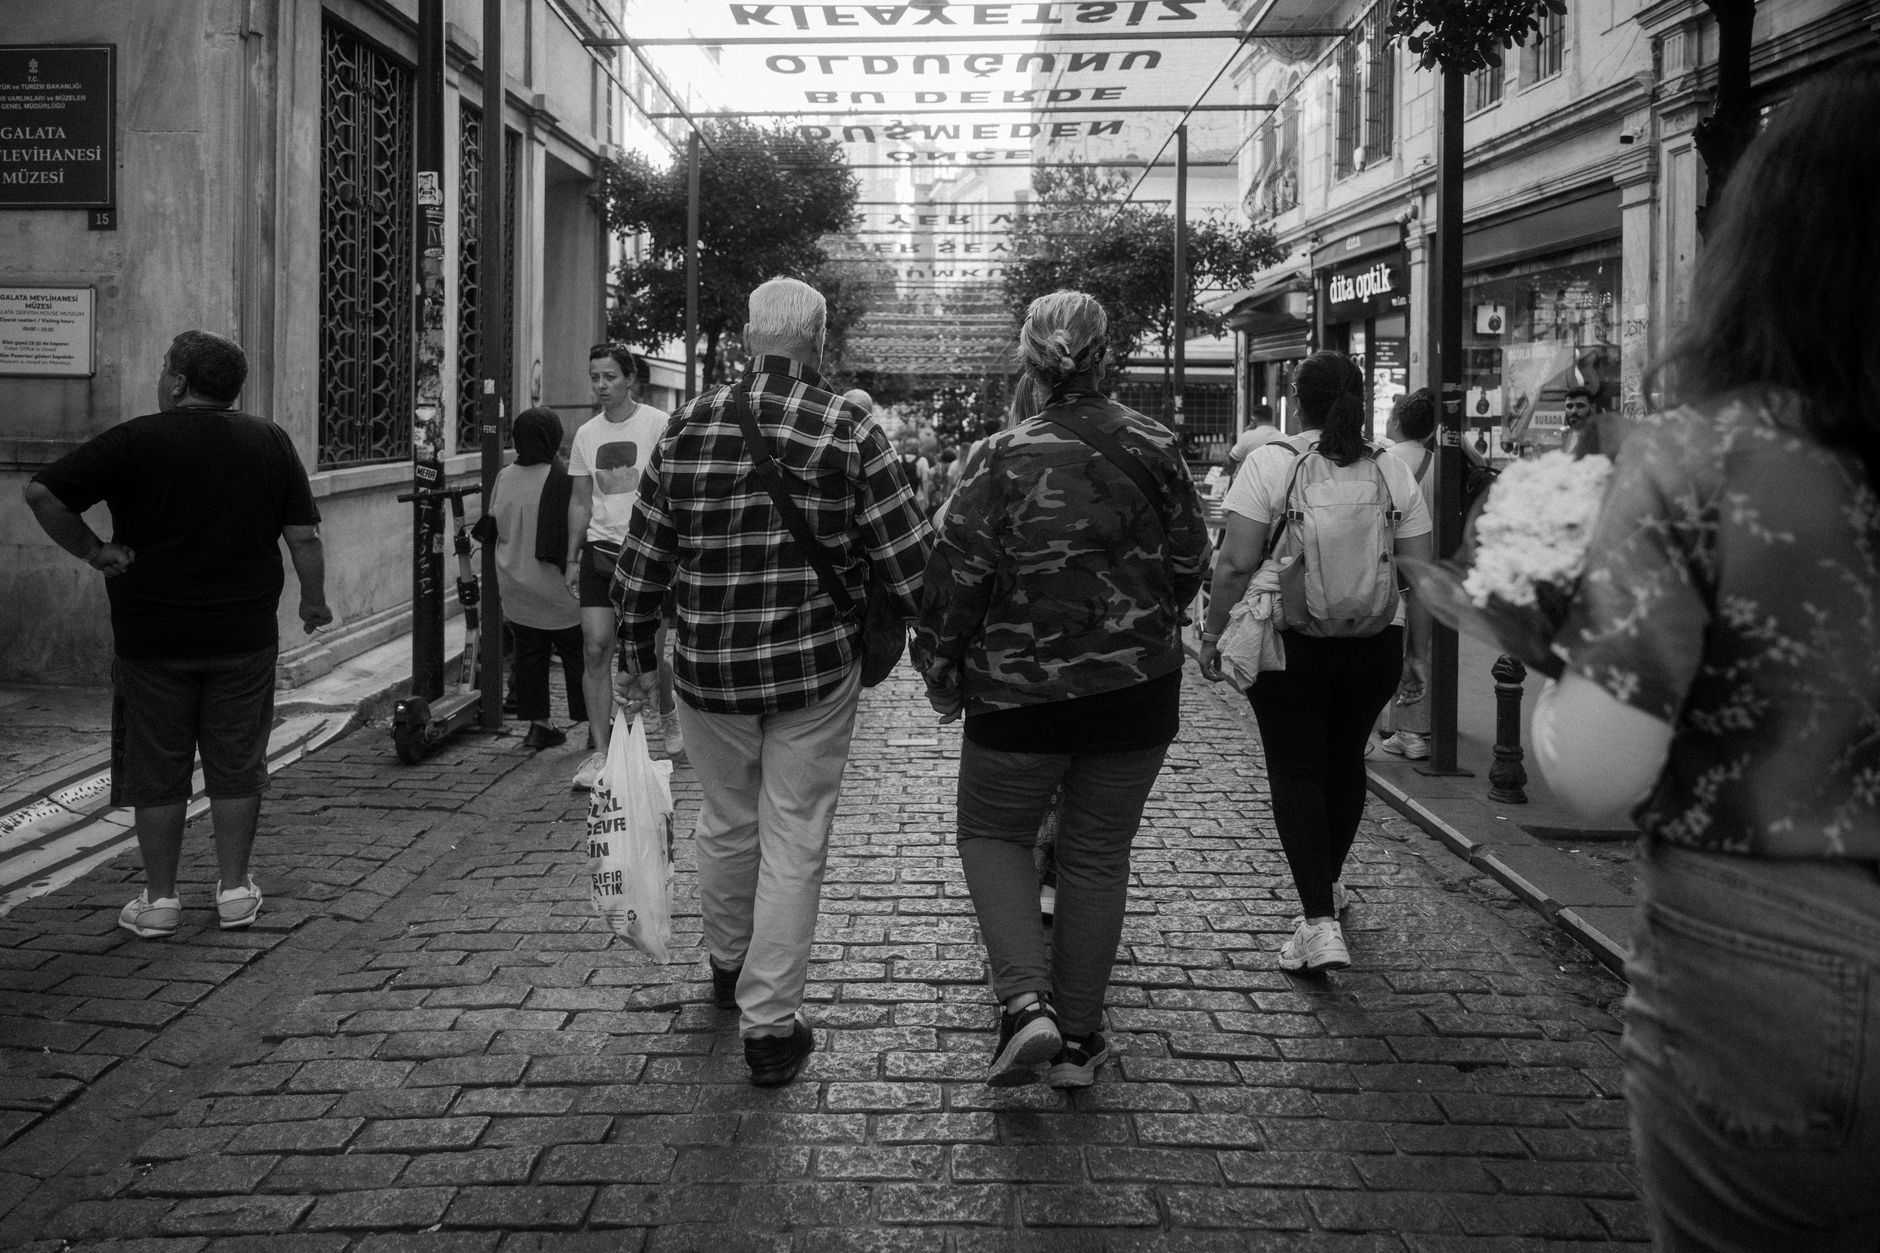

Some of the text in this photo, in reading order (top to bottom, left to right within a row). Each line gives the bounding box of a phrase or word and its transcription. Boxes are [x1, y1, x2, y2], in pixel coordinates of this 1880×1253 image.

[0, 126, 67, 139] GALATA
[0, 145, 101, 162] LEVİHANESİ
[2, 168, 65, 184] MÜZESİ
[96, 213, 109, 225] 15
[1330, 262, 1392, 304] dita optik
[25, 302, 52, 310] MÜZESİ
[1534, 415, 1563, 425] BURADA
[592, 870, 623, 885] SIFIR
